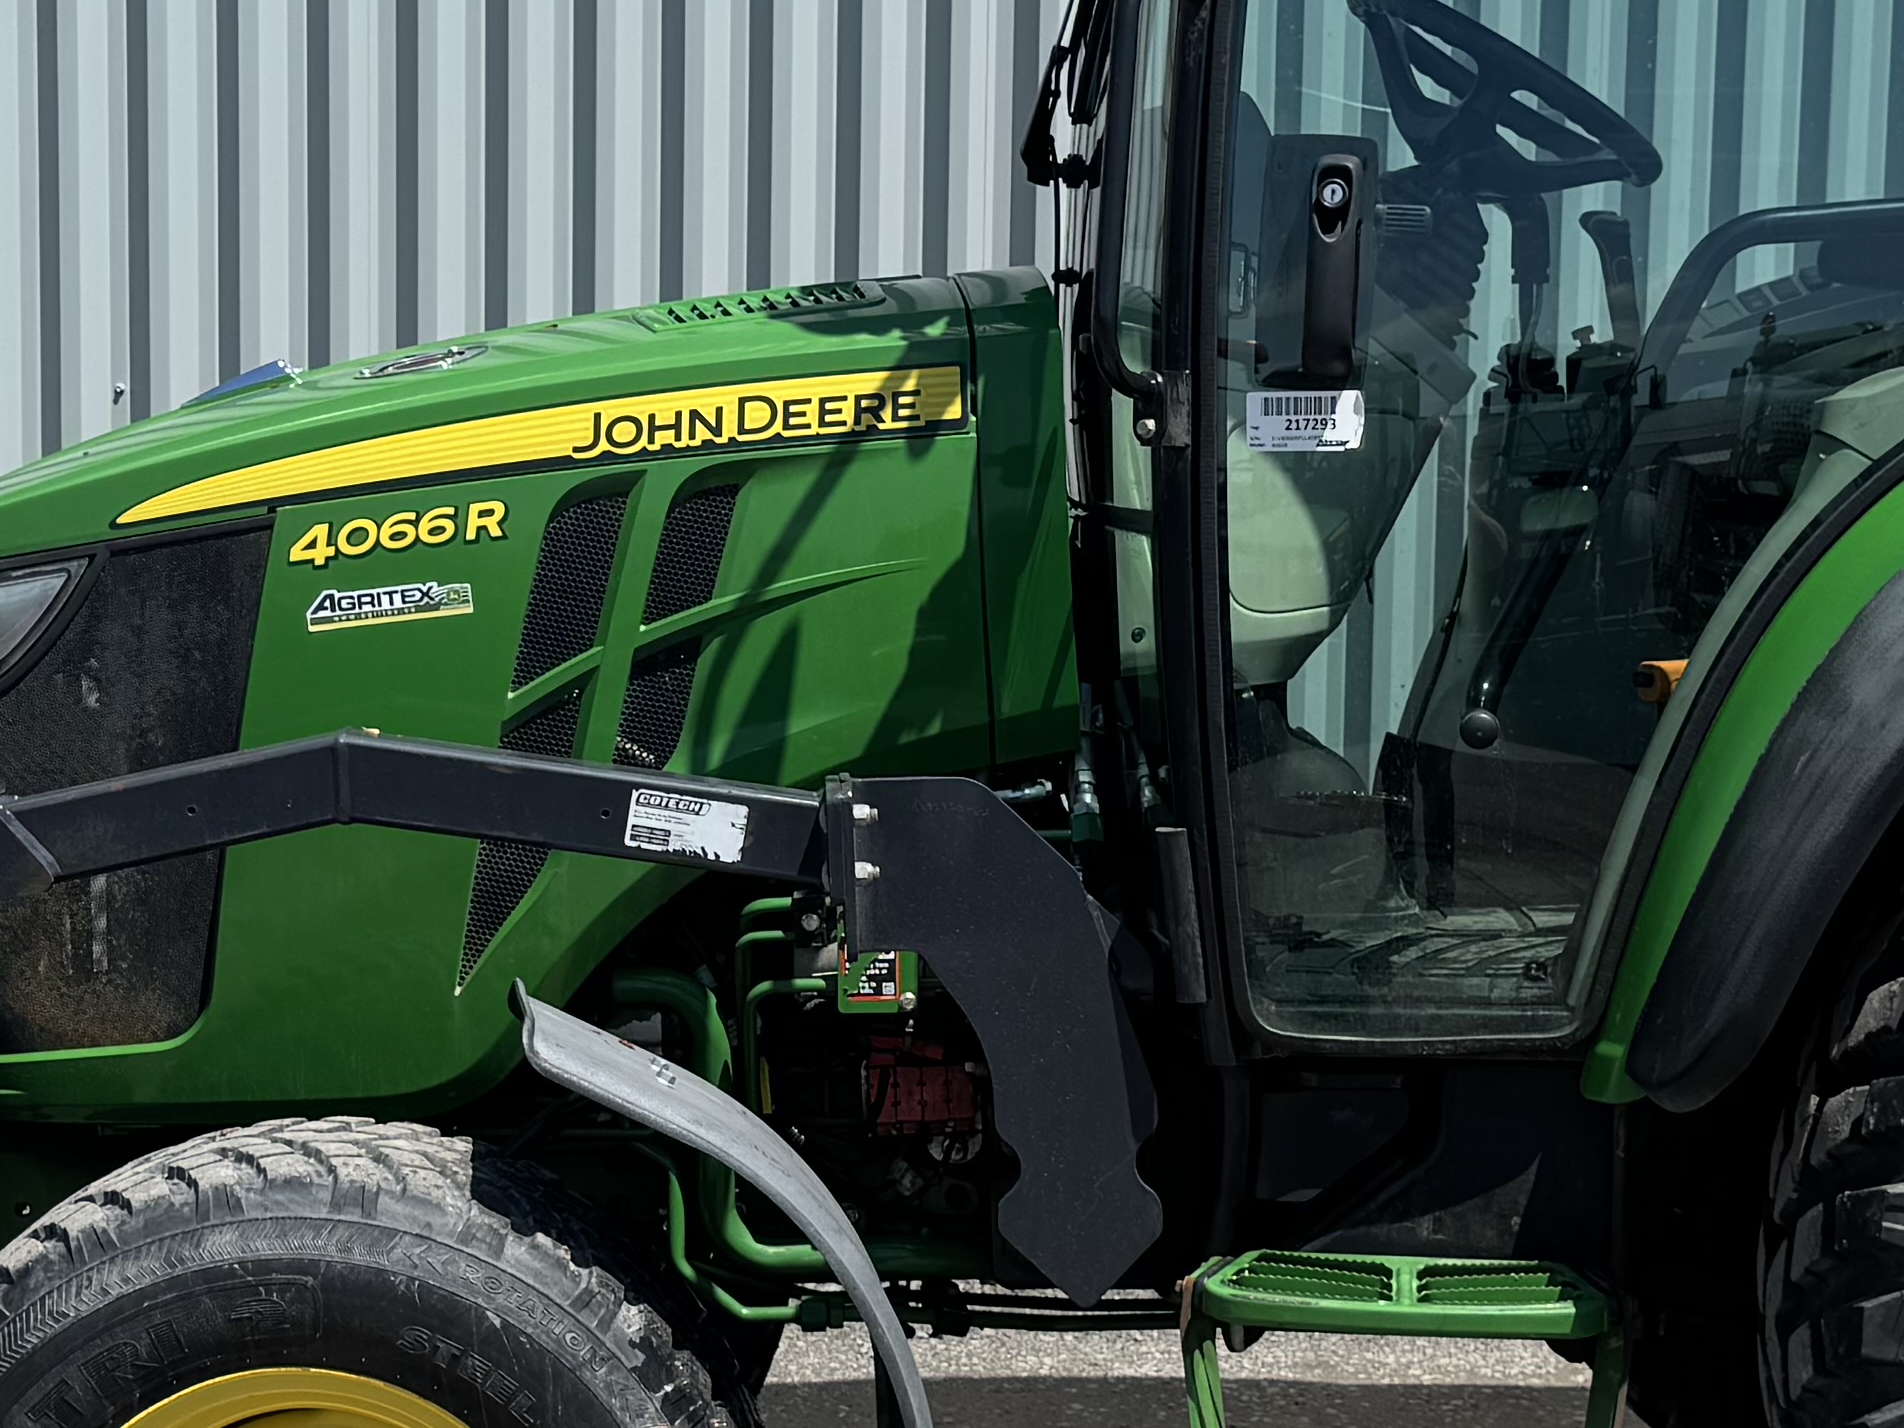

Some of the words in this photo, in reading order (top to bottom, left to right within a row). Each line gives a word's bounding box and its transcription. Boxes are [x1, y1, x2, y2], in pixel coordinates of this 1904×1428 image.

[571, 404, 724, 454] JOHN
[737, 389, 922, 437] DEERE
[1284, 417, 1337, 432] 217293
[309, 584, 437, 616] AGRITEX
[637, 792, 701, 813] COTECH
[461, 1261, 611, 1374] ROTATION
[398, 1325, 539, 1428] STEEL
